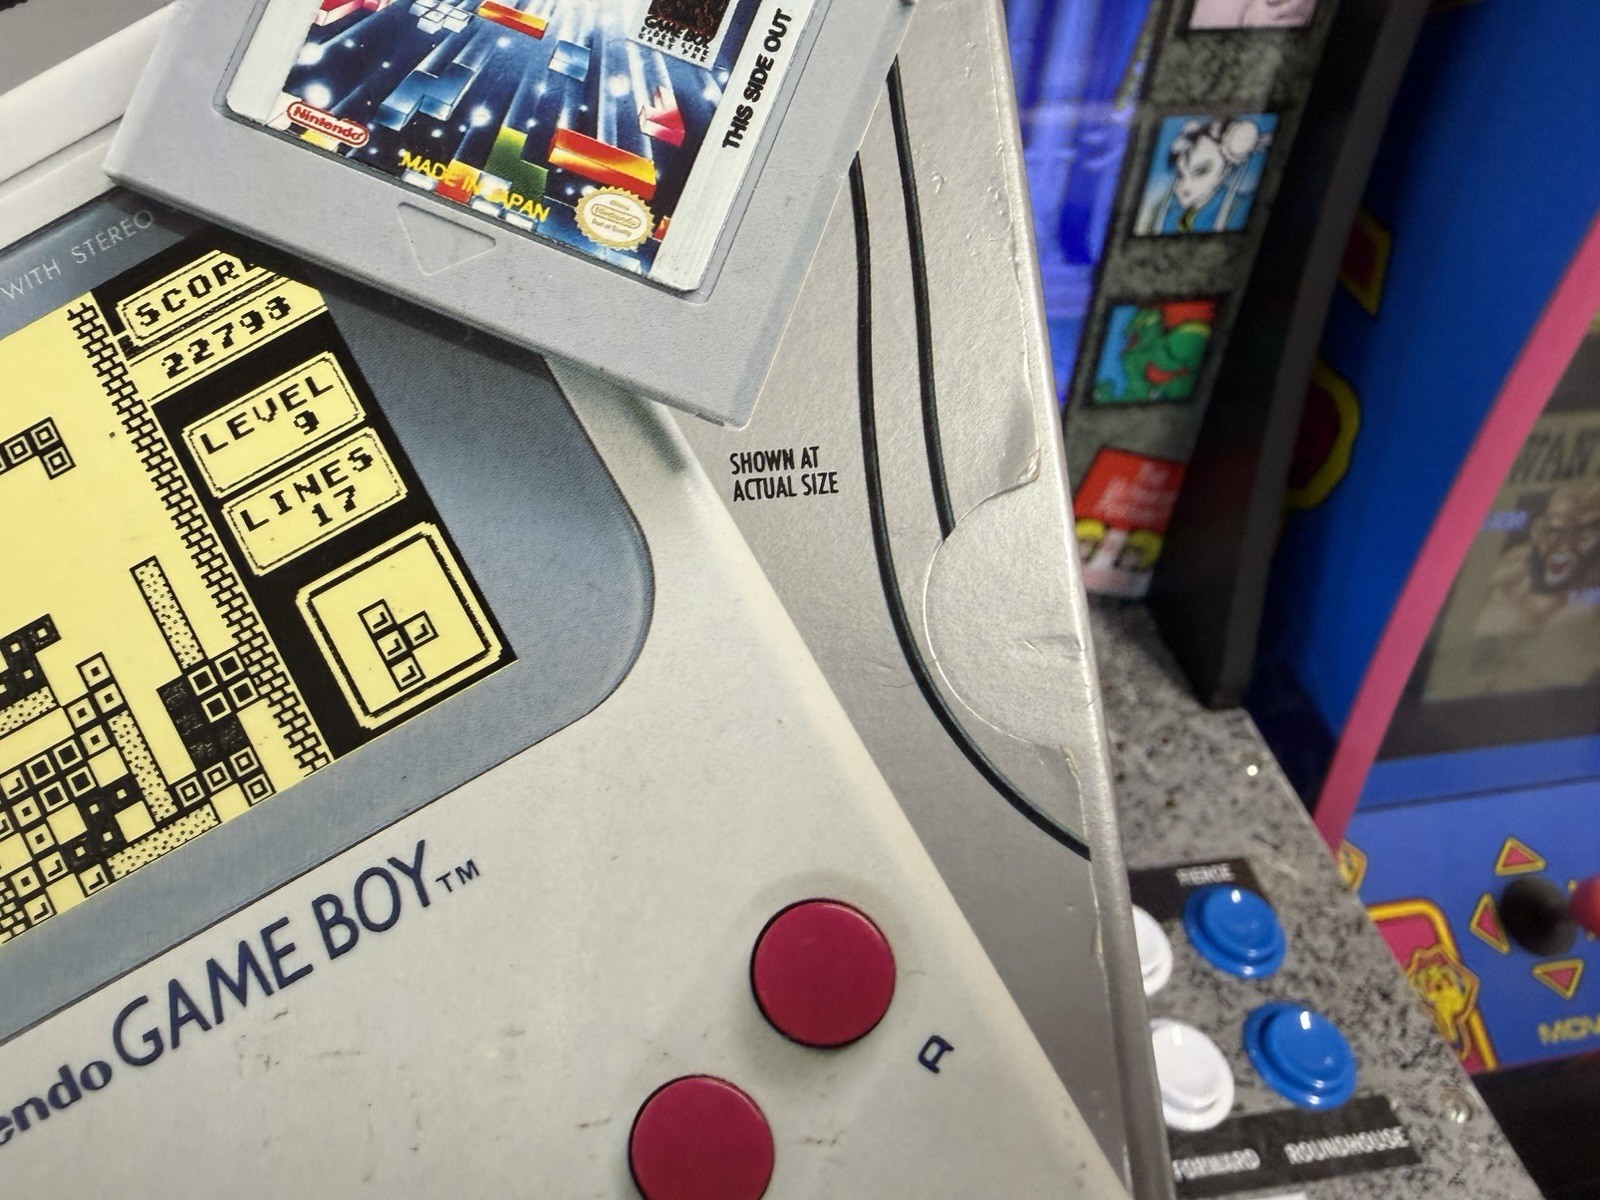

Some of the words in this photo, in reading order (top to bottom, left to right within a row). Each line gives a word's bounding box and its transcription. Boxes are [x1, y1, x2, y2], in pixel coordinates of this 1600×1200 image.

[721, 104, 754, 149] THIS
[743, 53, 775, 103] SIDE
[763, 7, 792, 53] OUT
[293, 106, 364, 140] Nintendo
[401, 150, 460, 188] MADE
[461, 173, 481, 197] IN
[0, 258, 62, 300] WITH
[70, 209, 154, 265] STEREO
[134, 256, 254, 328] SCOR
[160, 295, 292, 380] 22793
[199, 375, 335, 456] LEVEL
[293, 409, 320, 436] 9
[239, 446, 374, 533] LINES
[729, 448, 795, 476] SHOWN
[800, 445, 820, 470] AT
[733, 474, 798, 503] ACTUAL
[800, 471, 840, 496] SIZE
[311, 484, 357, 528] 17
[111, 916, 315, 1067] GAME
[311, 839, 431, 960] BOY
